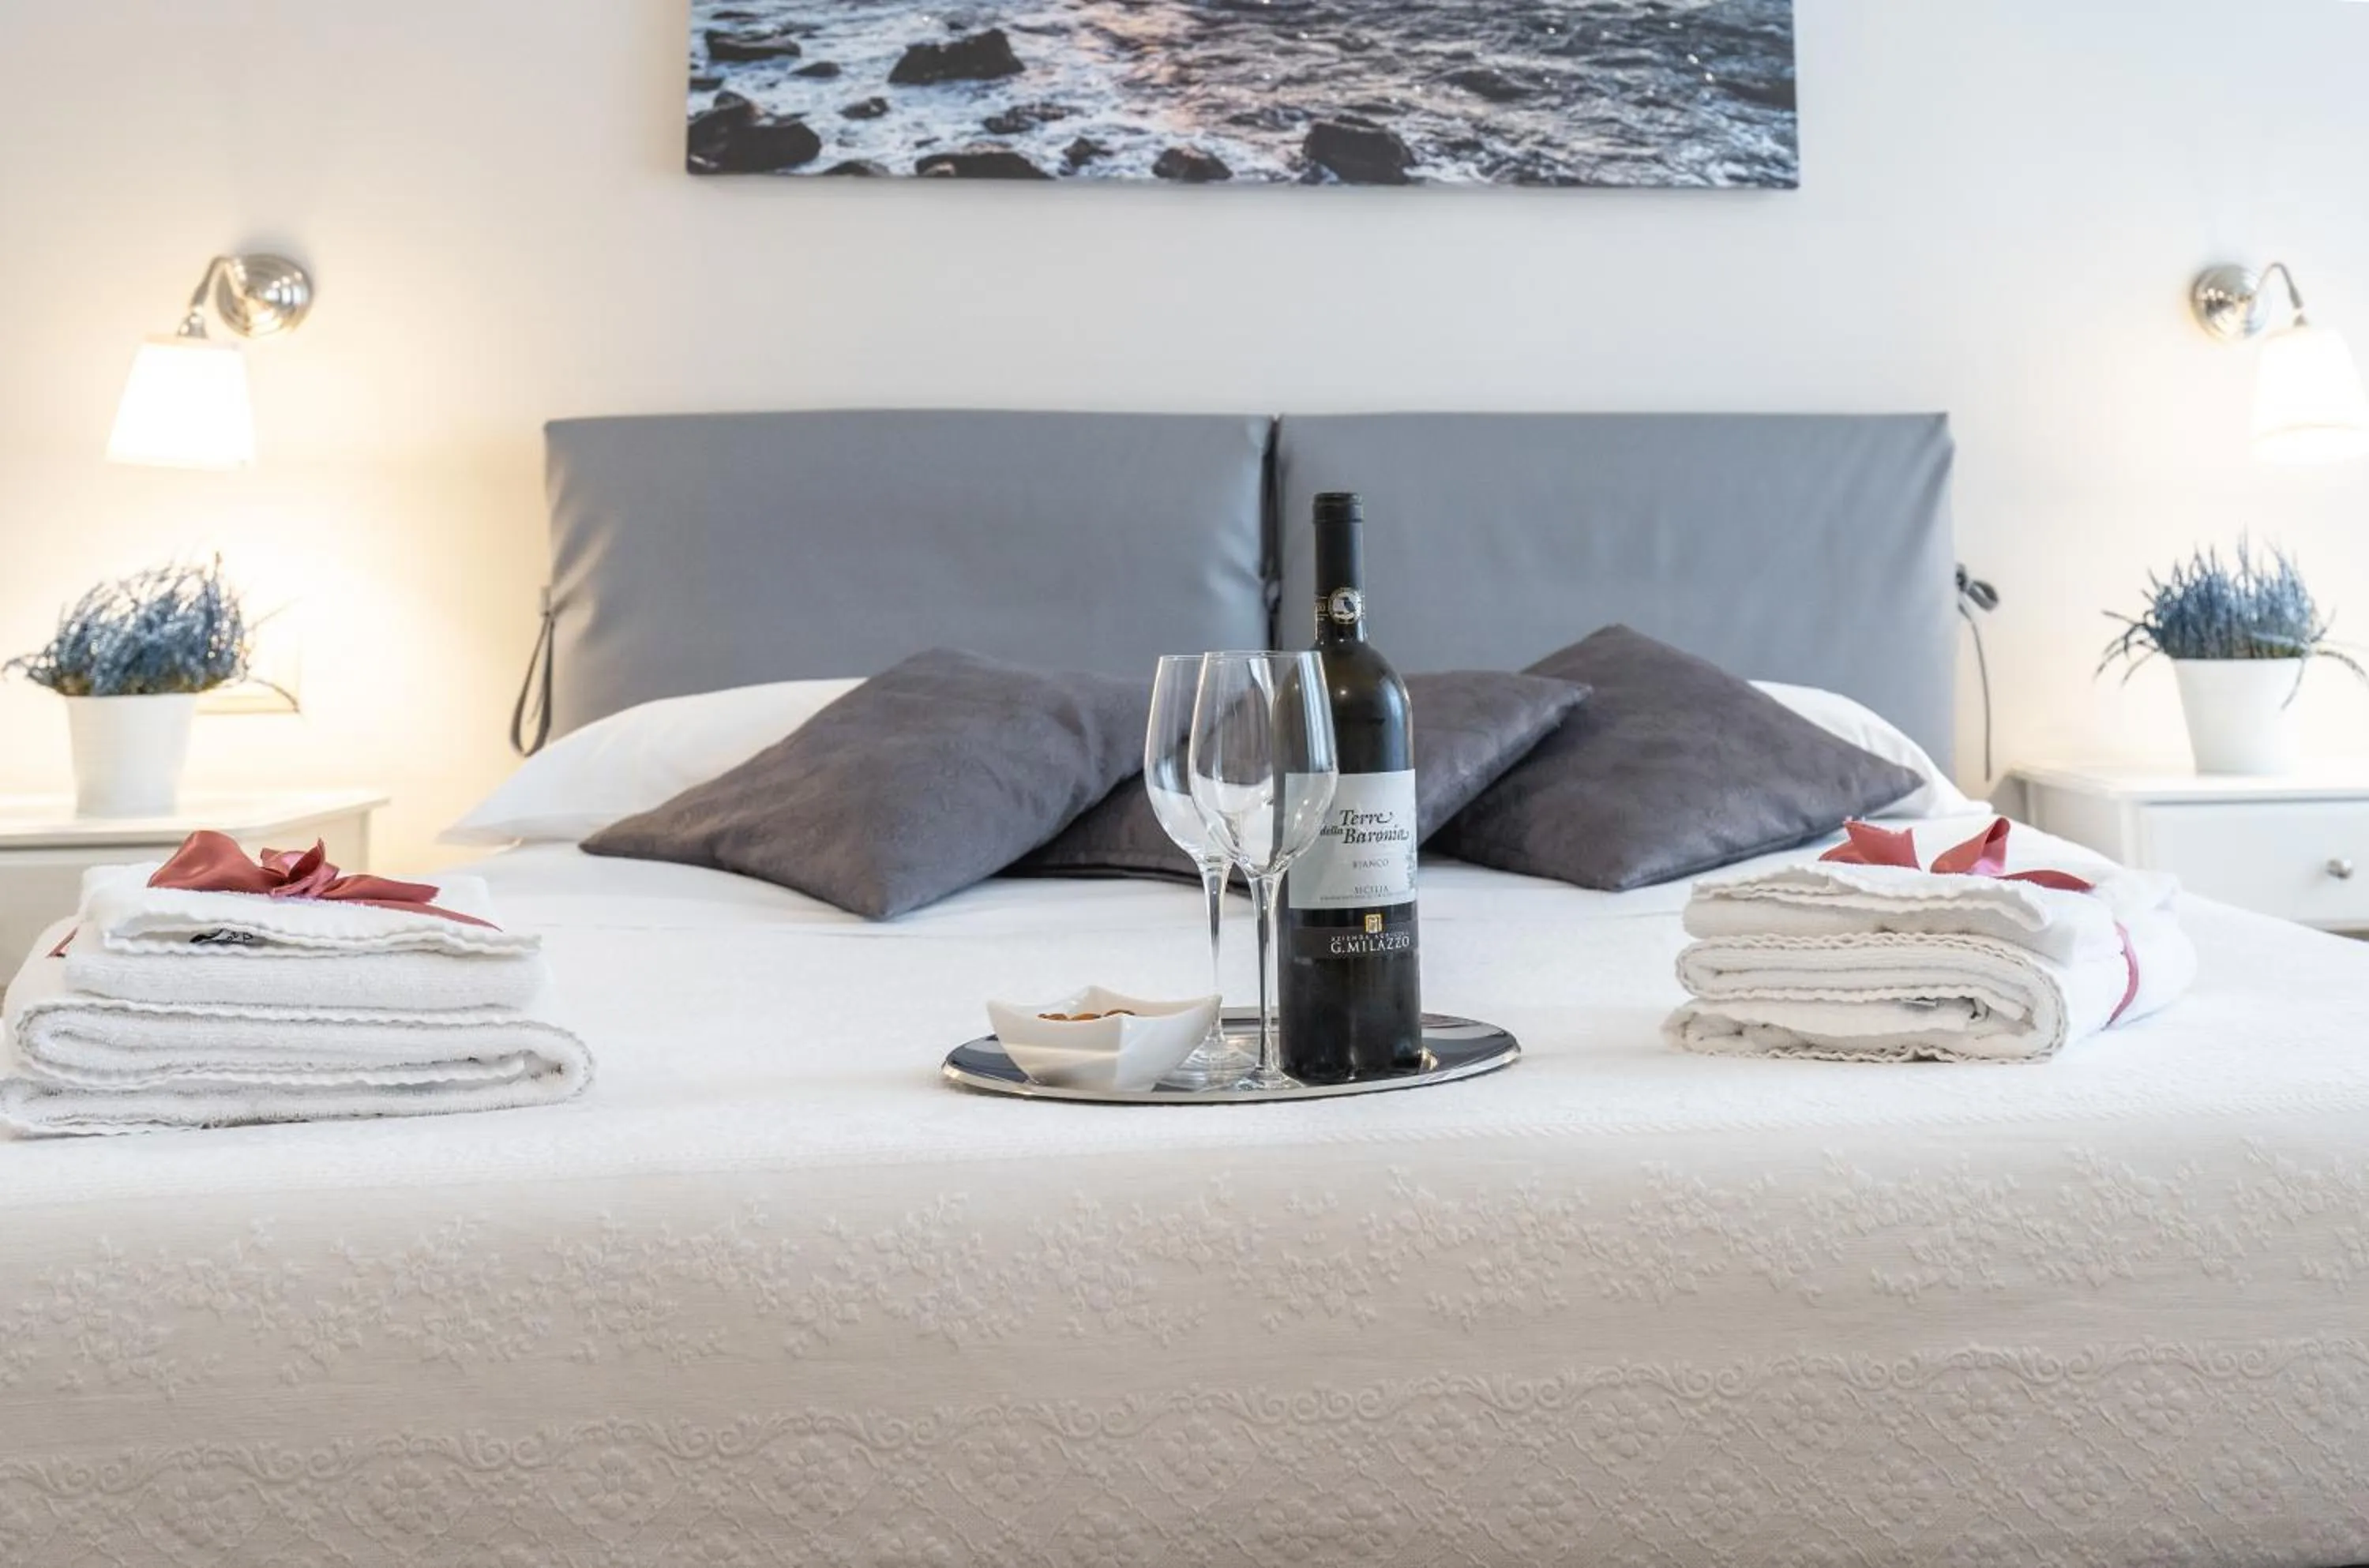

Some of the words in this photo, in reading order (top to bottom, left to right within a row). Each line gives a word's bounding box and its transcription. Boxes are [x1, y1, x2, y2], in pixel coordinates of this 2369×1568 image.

[1339, 808, 1393, 826] Terre
[1320, 824, 1343, 836] della
[1342, 824, 1410, 844] Baronia
